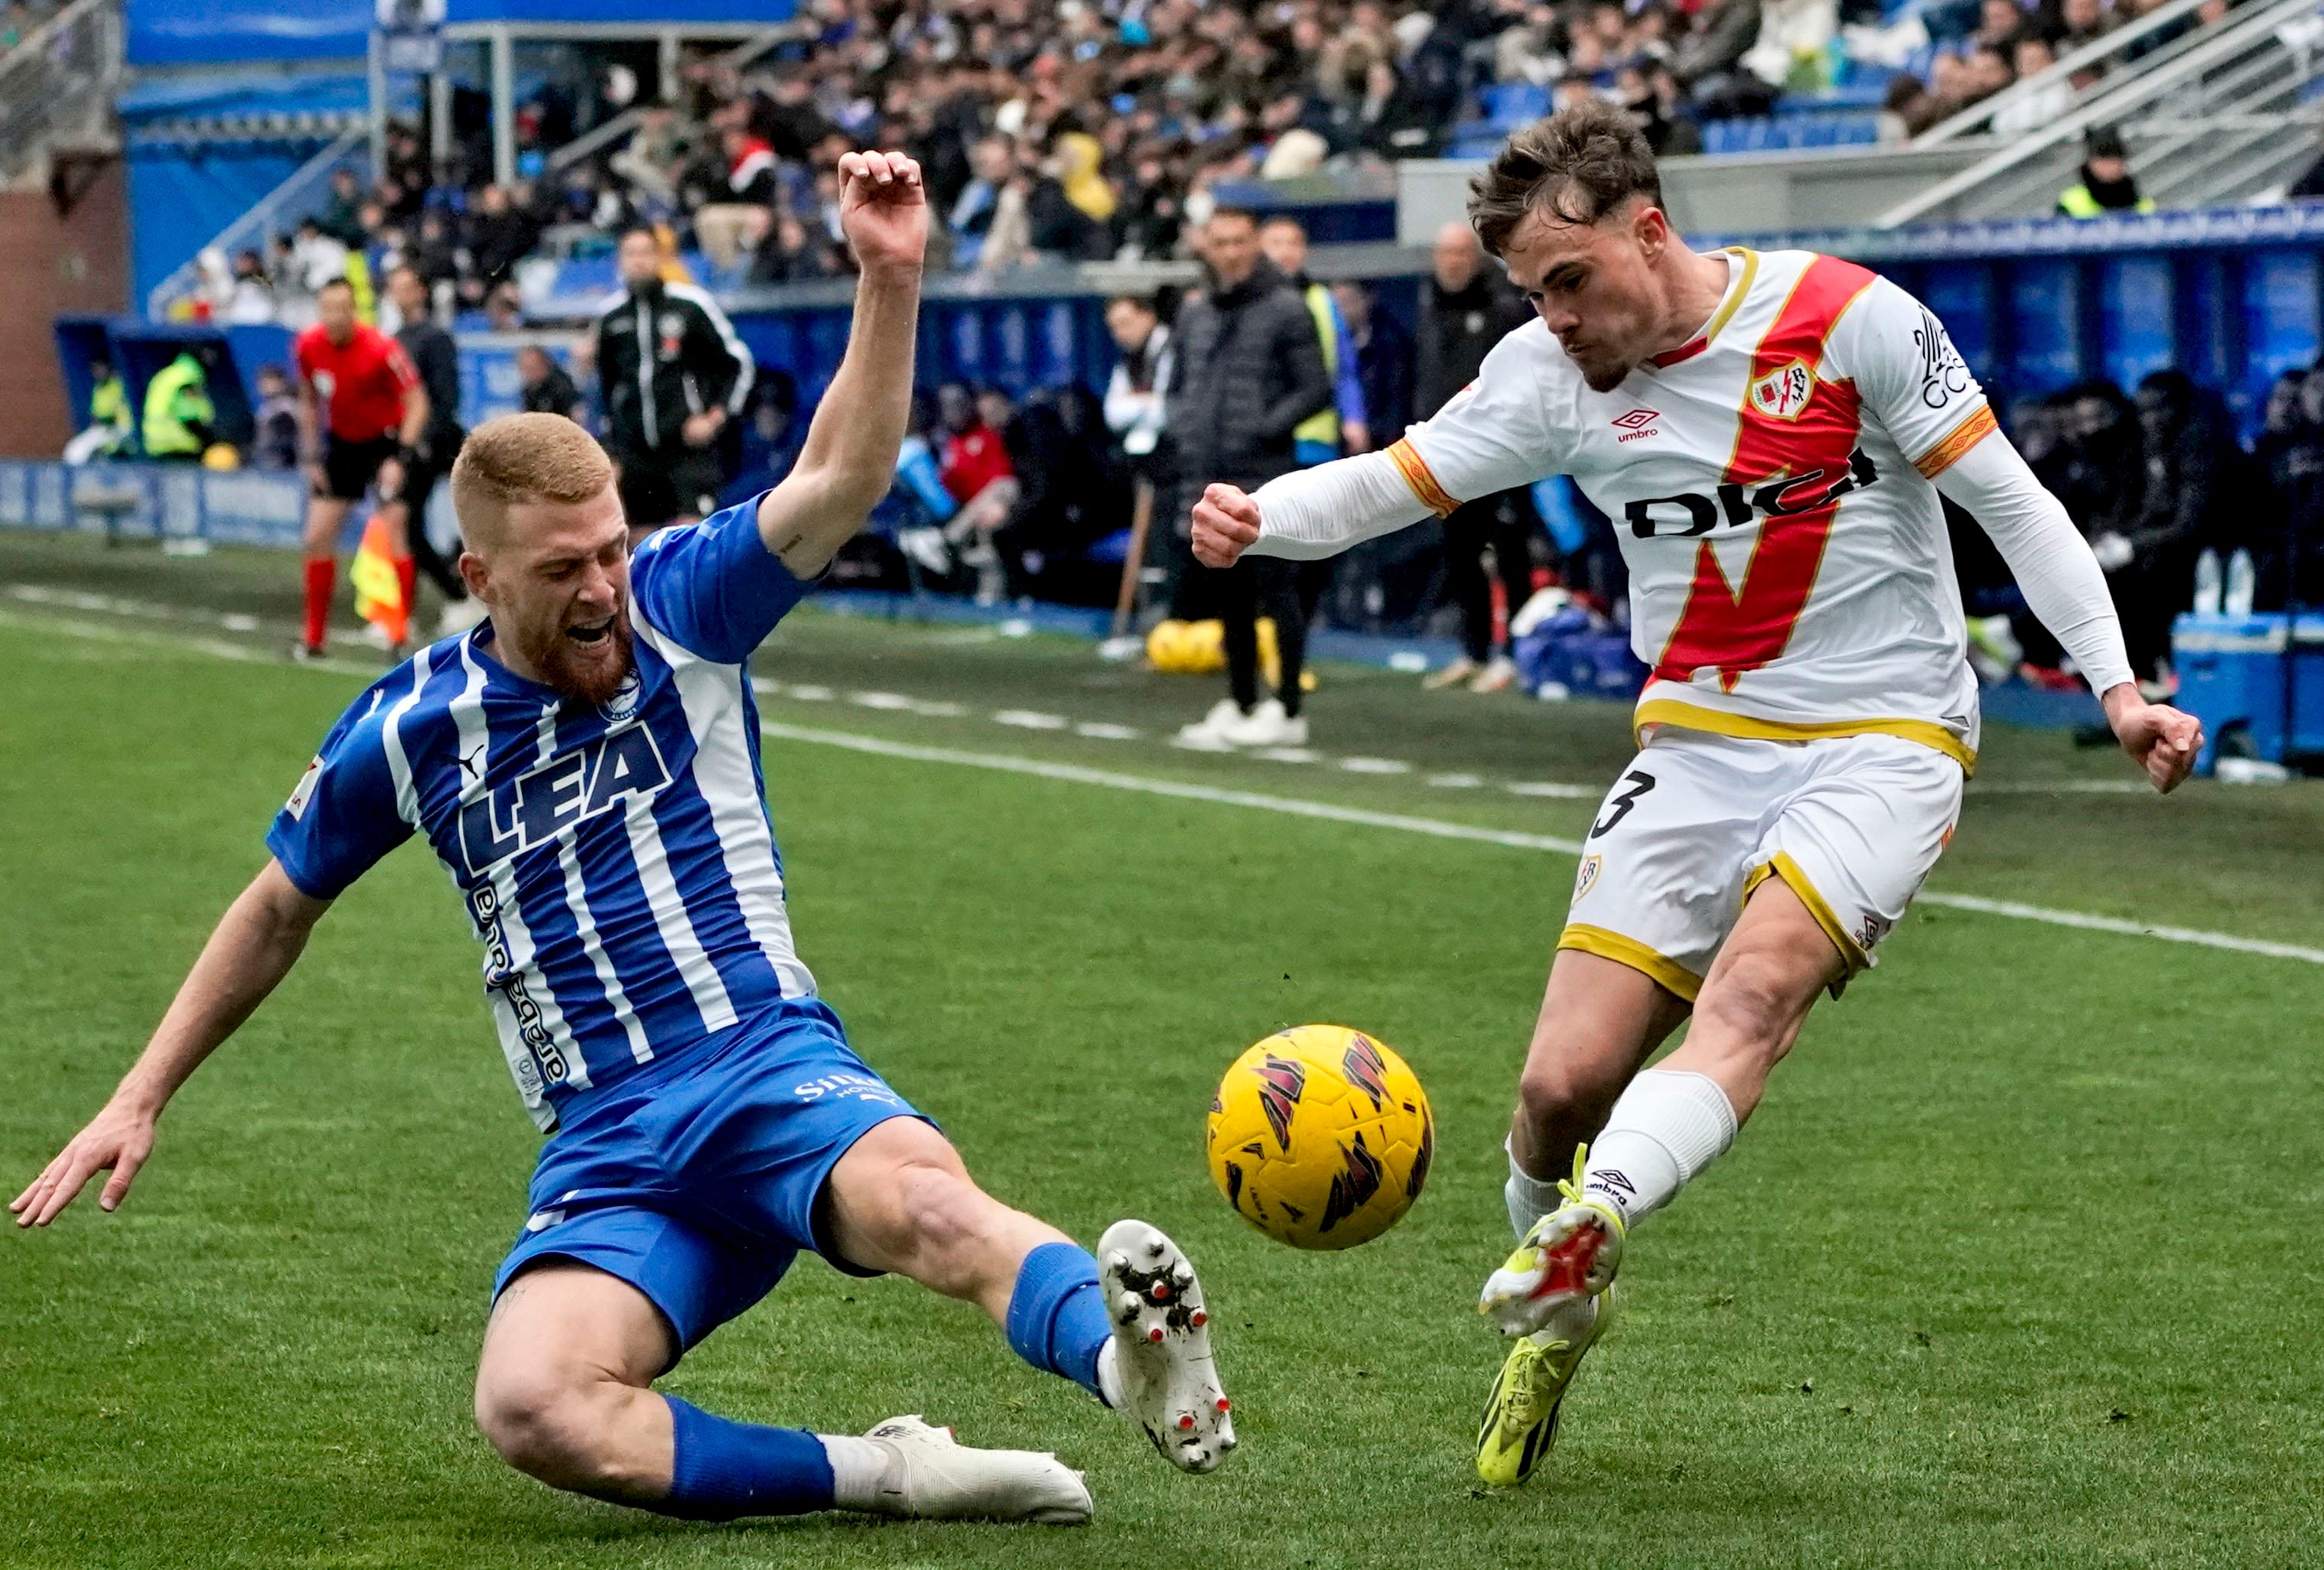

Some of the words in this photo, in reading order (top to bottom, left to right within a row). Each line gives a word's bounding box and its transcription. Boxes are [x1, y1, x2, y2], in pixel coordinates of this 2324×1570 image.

[1618, 428, 1658, 443] umbro
[457, 720, 674, 879] LEA
[1590, 769, 1655, 840] 3
